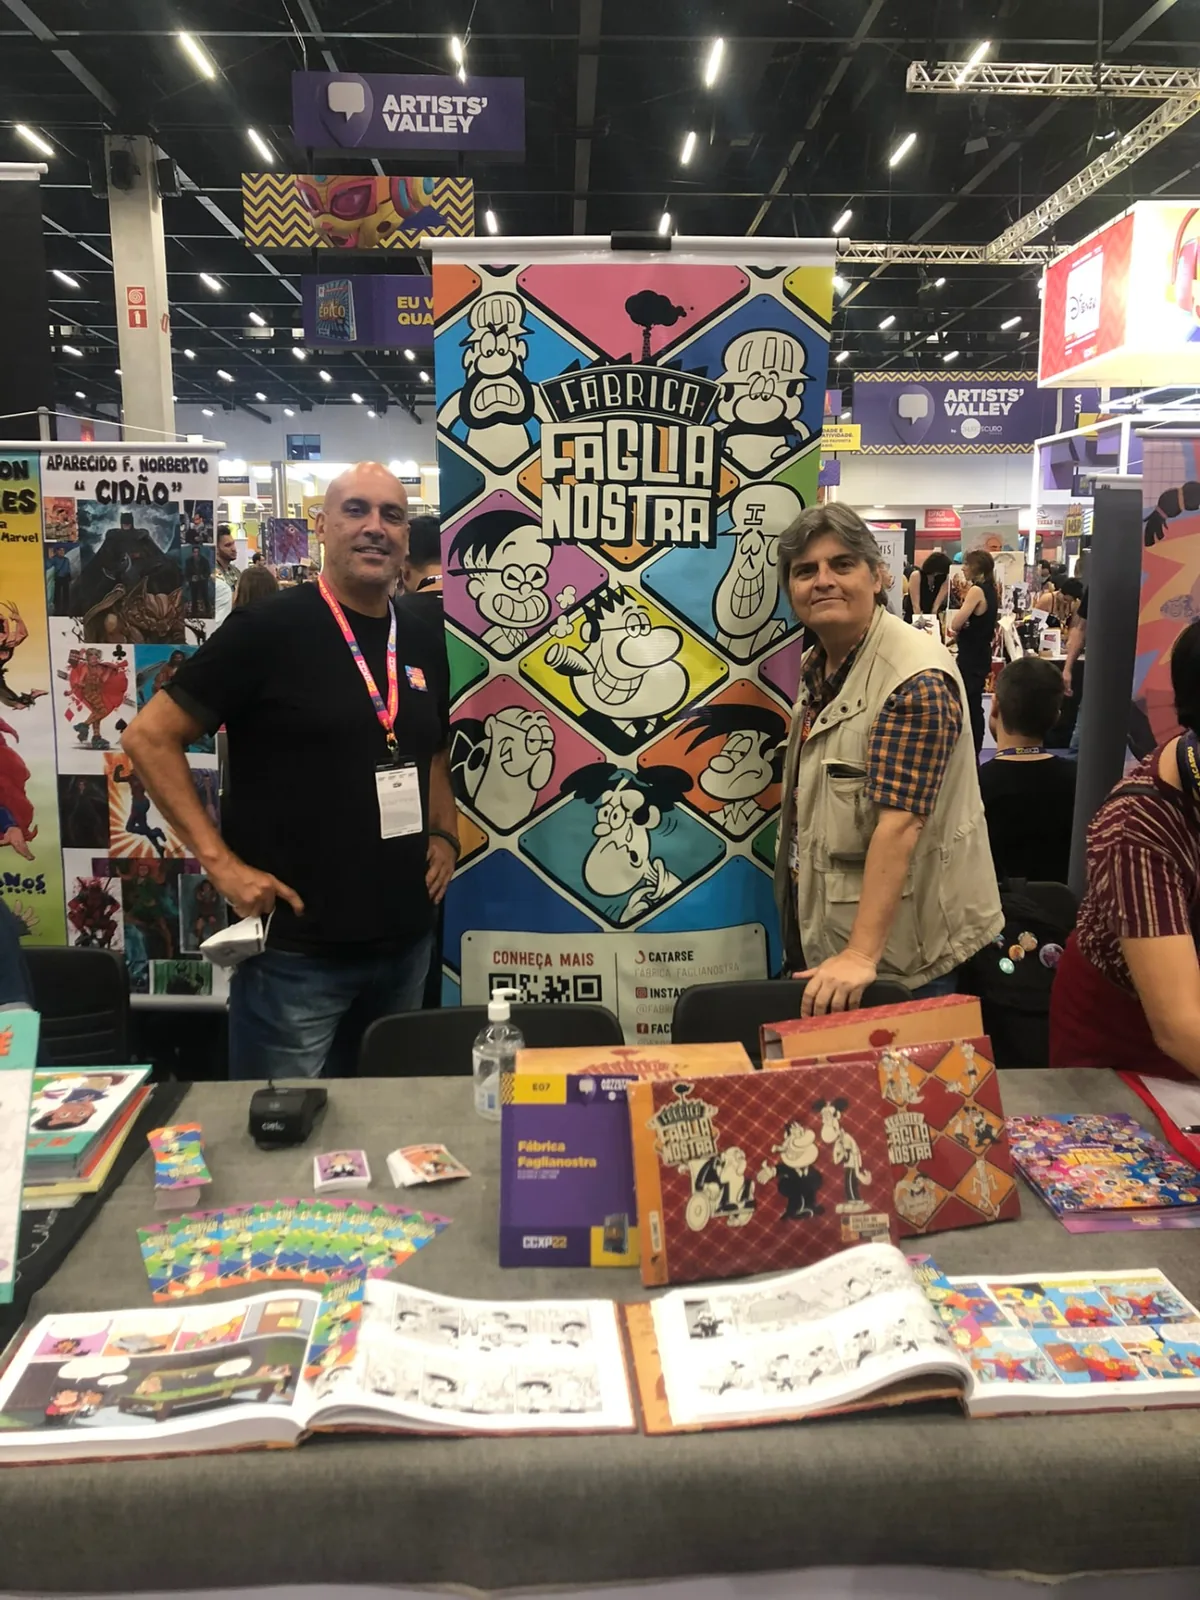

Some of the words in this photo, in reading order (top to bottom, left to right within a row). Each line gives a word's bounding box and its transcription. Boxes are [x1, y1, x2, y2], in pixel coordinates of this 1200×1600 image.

[382, 94, 488, 116] ARTISTS’
[382, 113, 474, 134] VALLEY
[397, 296, 420, 309] EU
[944, 388, 1024, 403] ARTISTS’
[944, 402, 1013, 416] VALLEY
[541, 419, 715, 486] FAGLIA
[46, 454, 117, 472] APARECIDO
[123, 456, 134, 473] F.
[139, 455, 209, 474] NORBERTO
[541, 483, 712, 542] NOSTRA
[1, 532, 39, 543] Marvel
[0, 872, 46, 891] NOS
[493, 950, 553, 970] CONHEÇA
[560, 952, 594, 967] MAIS
[648, 950, 694, 962] CATARSE
[677, 962, 739, 979] FAGLIANOSTRA
[650, 987, 686, 999] INSTA
[651, 1023, 672, 1034] FAC
[532, 1082, 551, 1092] E07
[517, 1140, 566, 1153] Fábrica
[517, 1155, 598, 1169] Faglianostra
[522, 1235, 567, 1249] CCXP22
